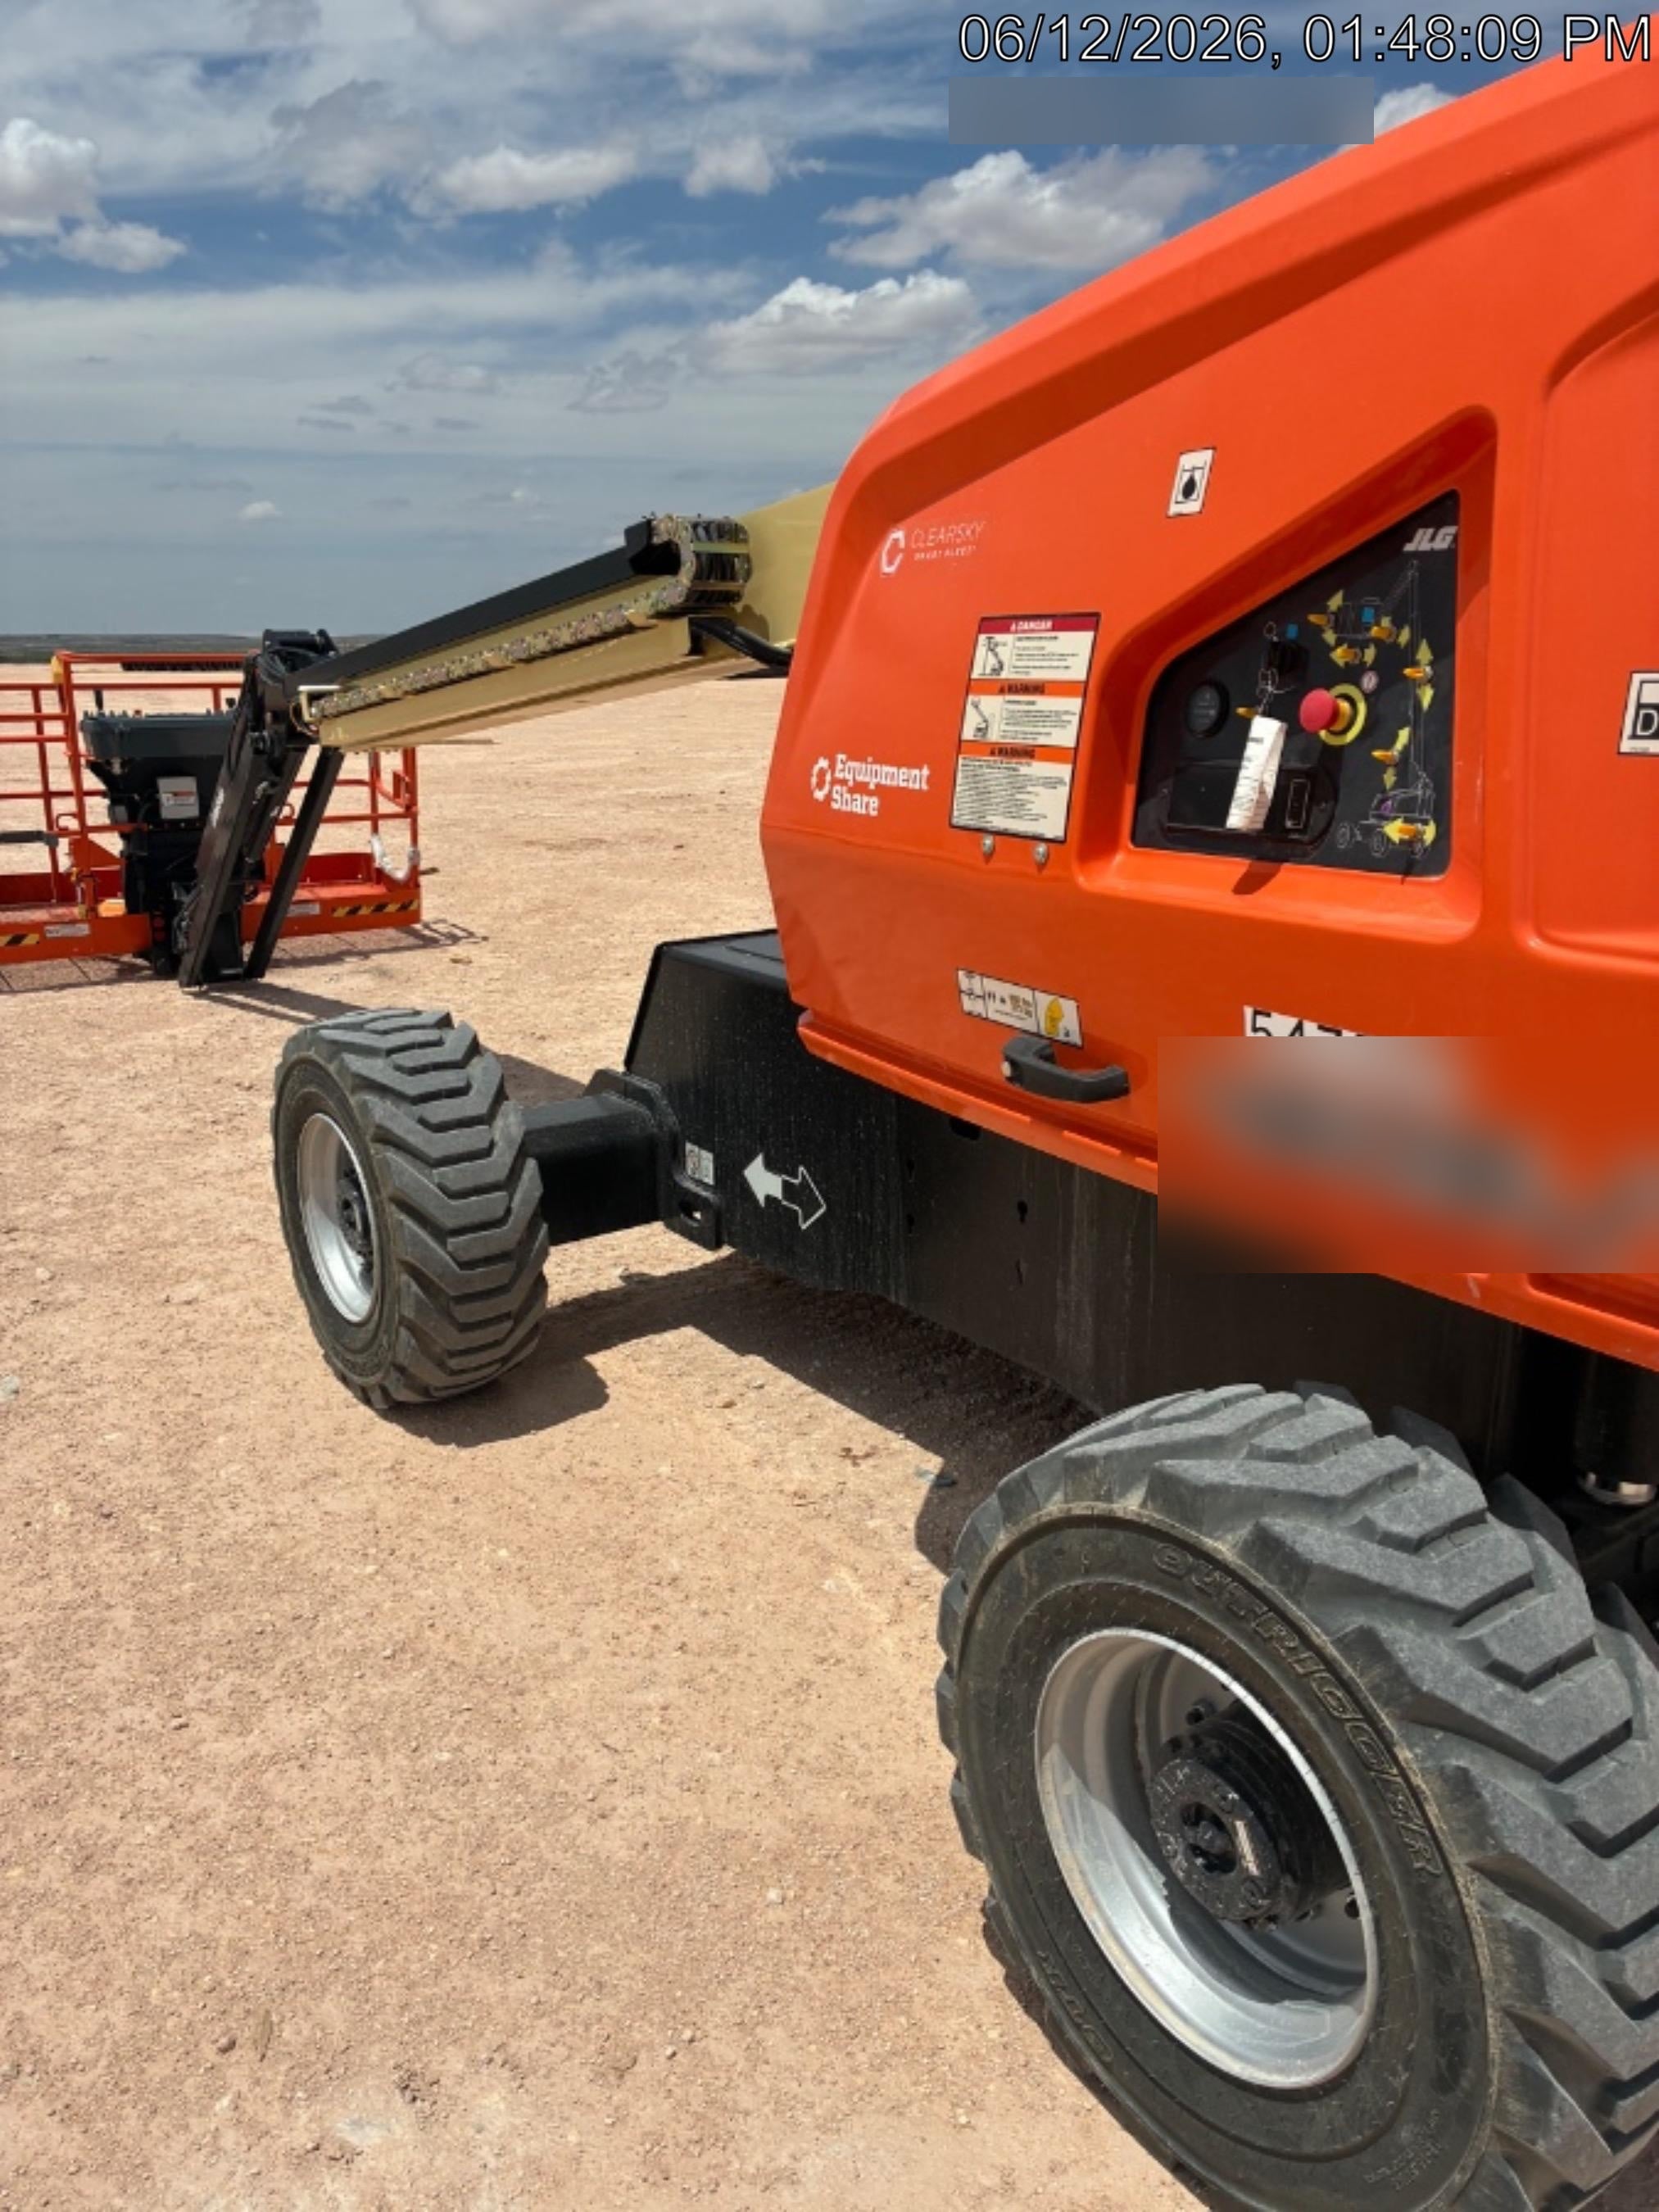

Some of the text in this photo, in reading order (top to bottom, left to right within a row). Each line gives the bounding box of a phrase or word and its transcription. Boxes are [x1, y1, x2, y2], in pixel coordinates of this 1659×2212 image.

[1402, 525, 1458, 551] JLG
[834, 753, 931, 791] Equipment
[830, 783, 880, 817] Share
